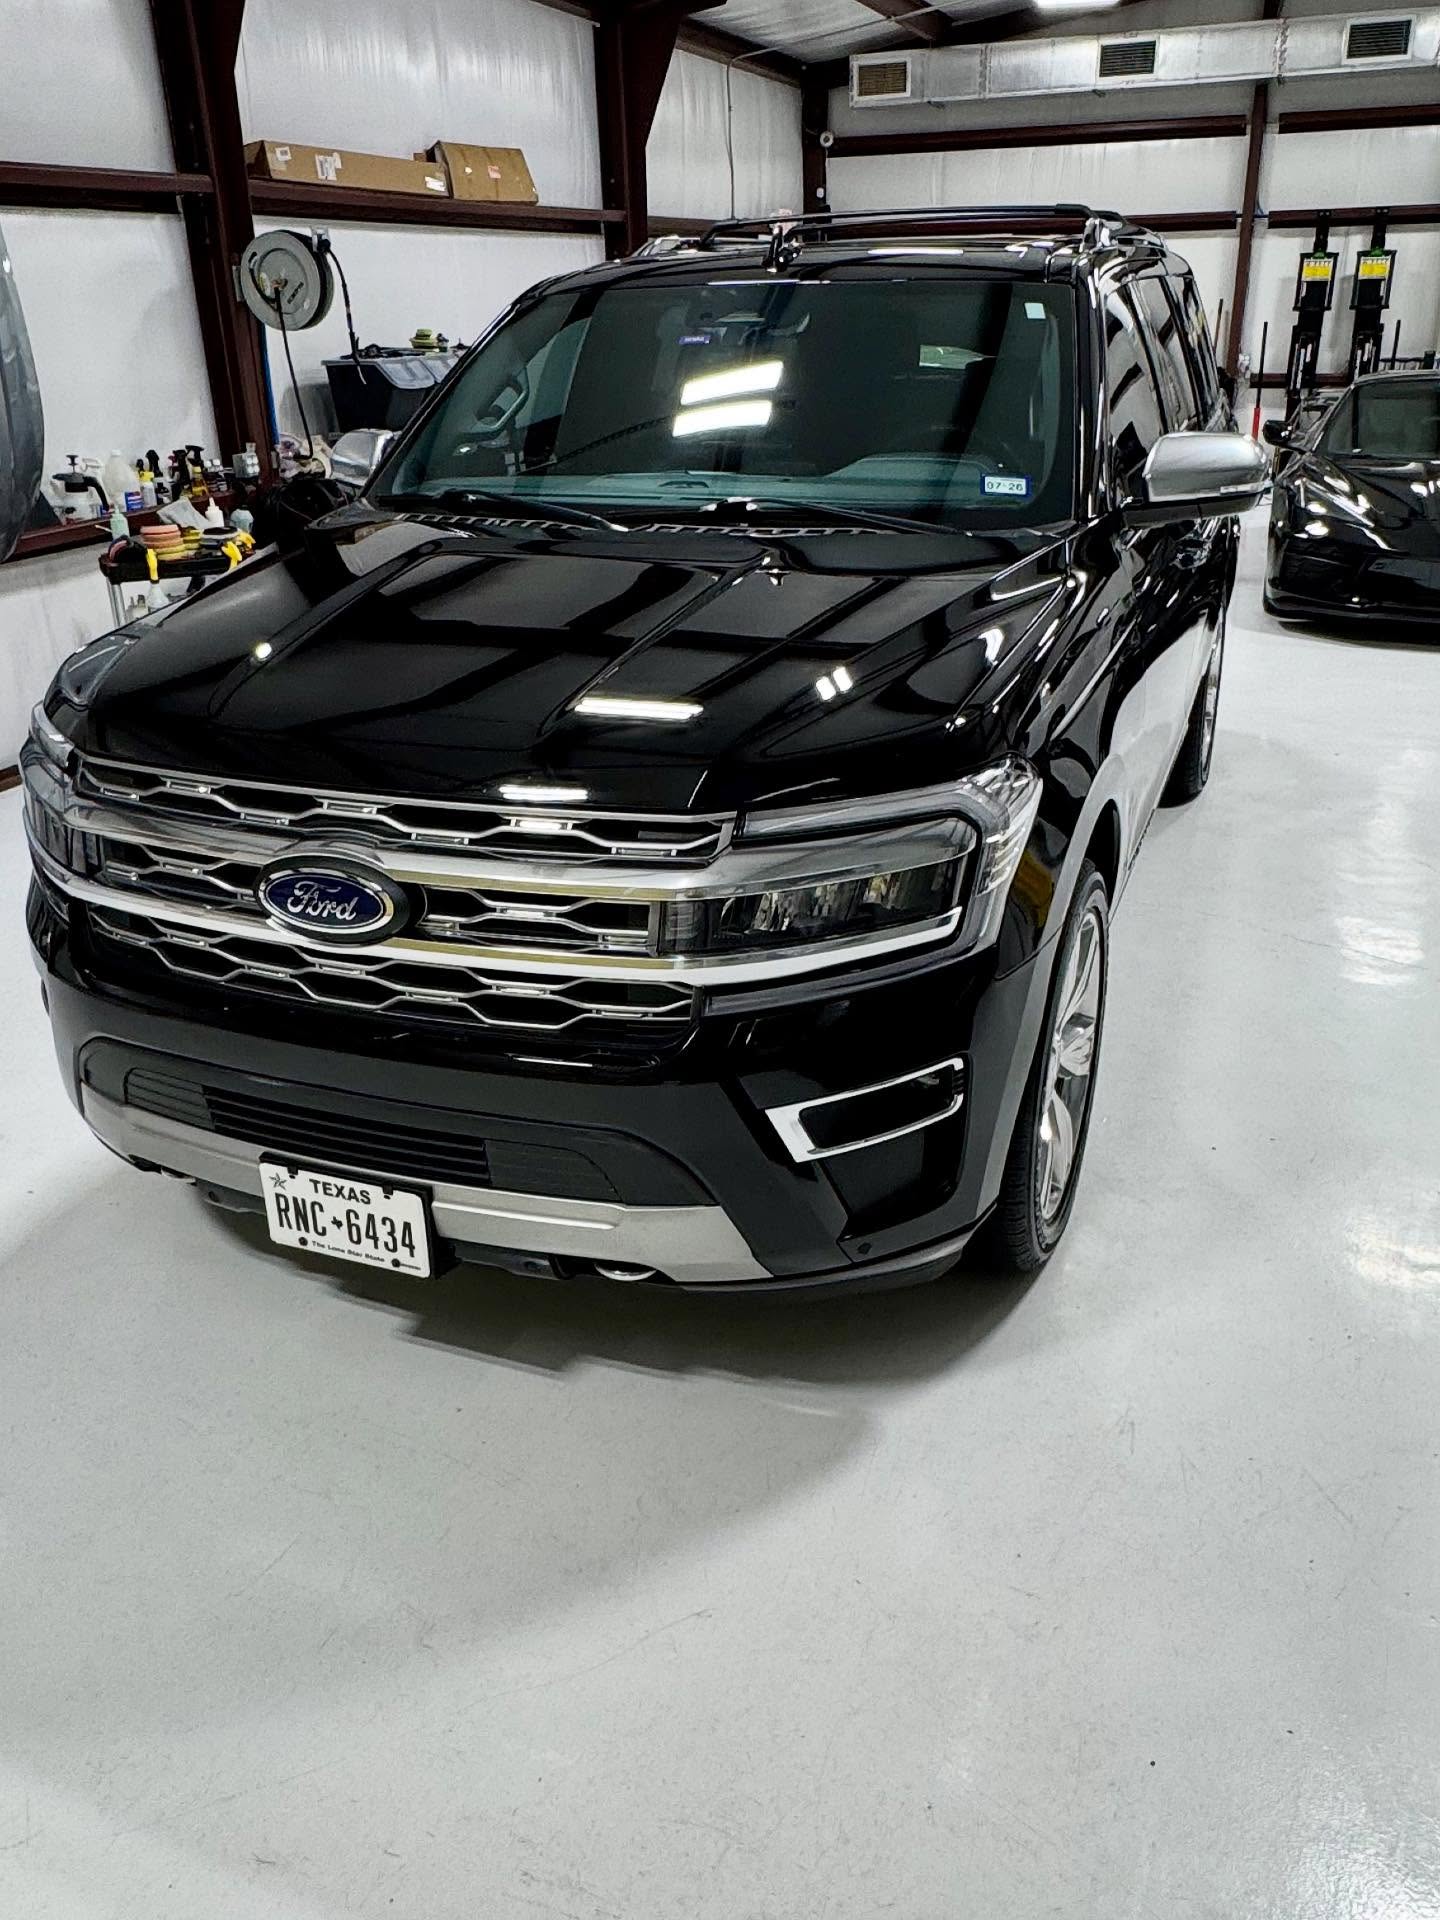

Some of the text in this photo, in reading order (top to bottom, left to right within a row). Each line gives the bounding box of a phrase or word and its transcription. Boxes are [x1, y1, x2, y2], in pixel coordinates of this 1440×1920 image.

[286, 880, 360, 921] Ford
[309, 1178, 371, 1205] TEXAS
[275, 1192, 416, 1258] RNC 6434
